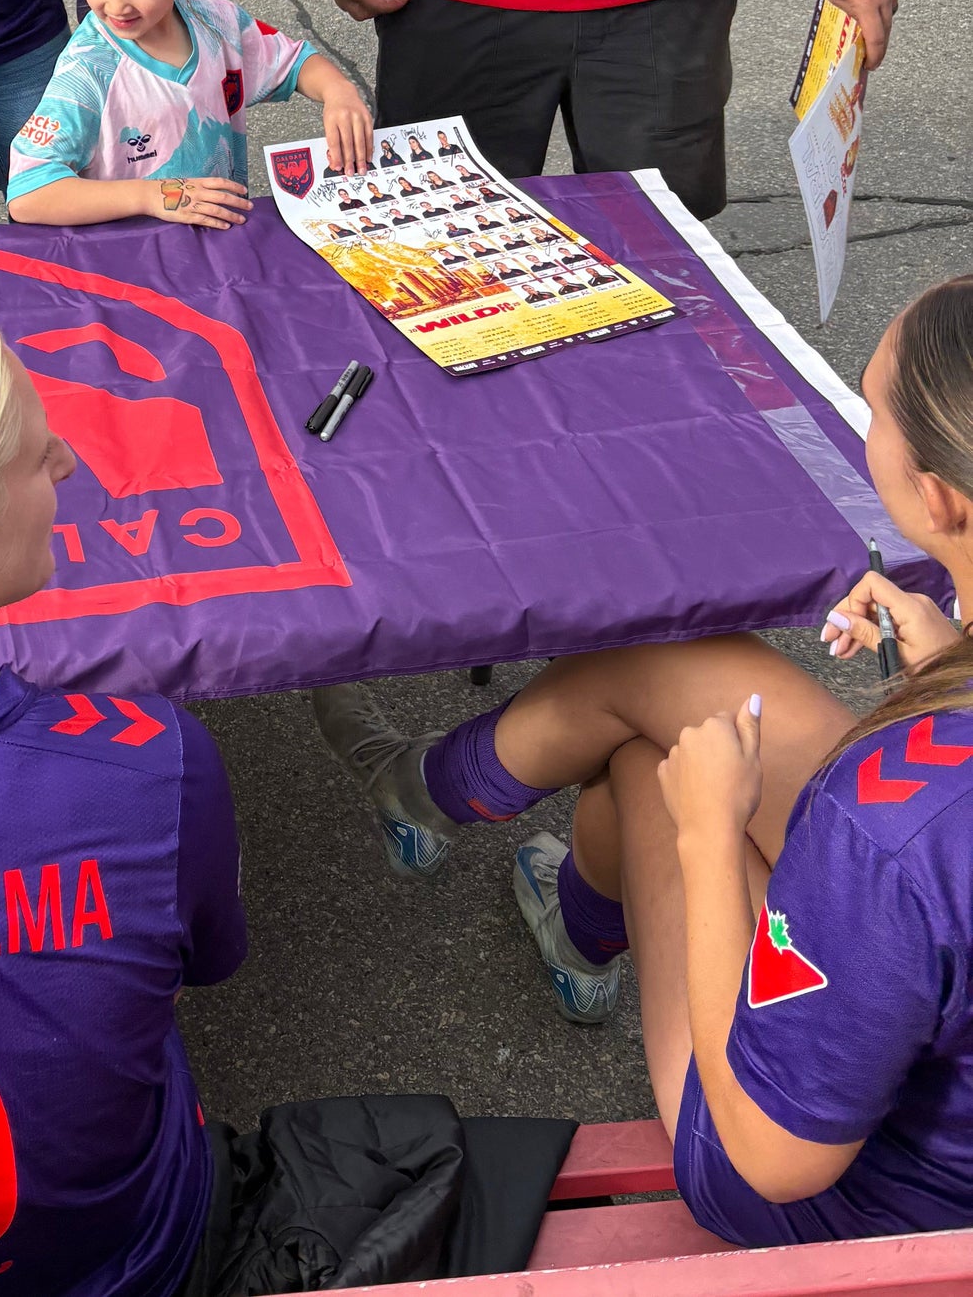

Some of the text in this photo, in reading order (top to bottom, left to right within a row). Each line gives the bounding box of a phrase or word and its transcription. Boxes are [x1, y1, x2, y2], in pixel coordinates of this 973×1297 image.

[127, 150, 157, 164] hummel
[415, 307, 500, 333] WILD
[497, 302, 515, 312] FC
